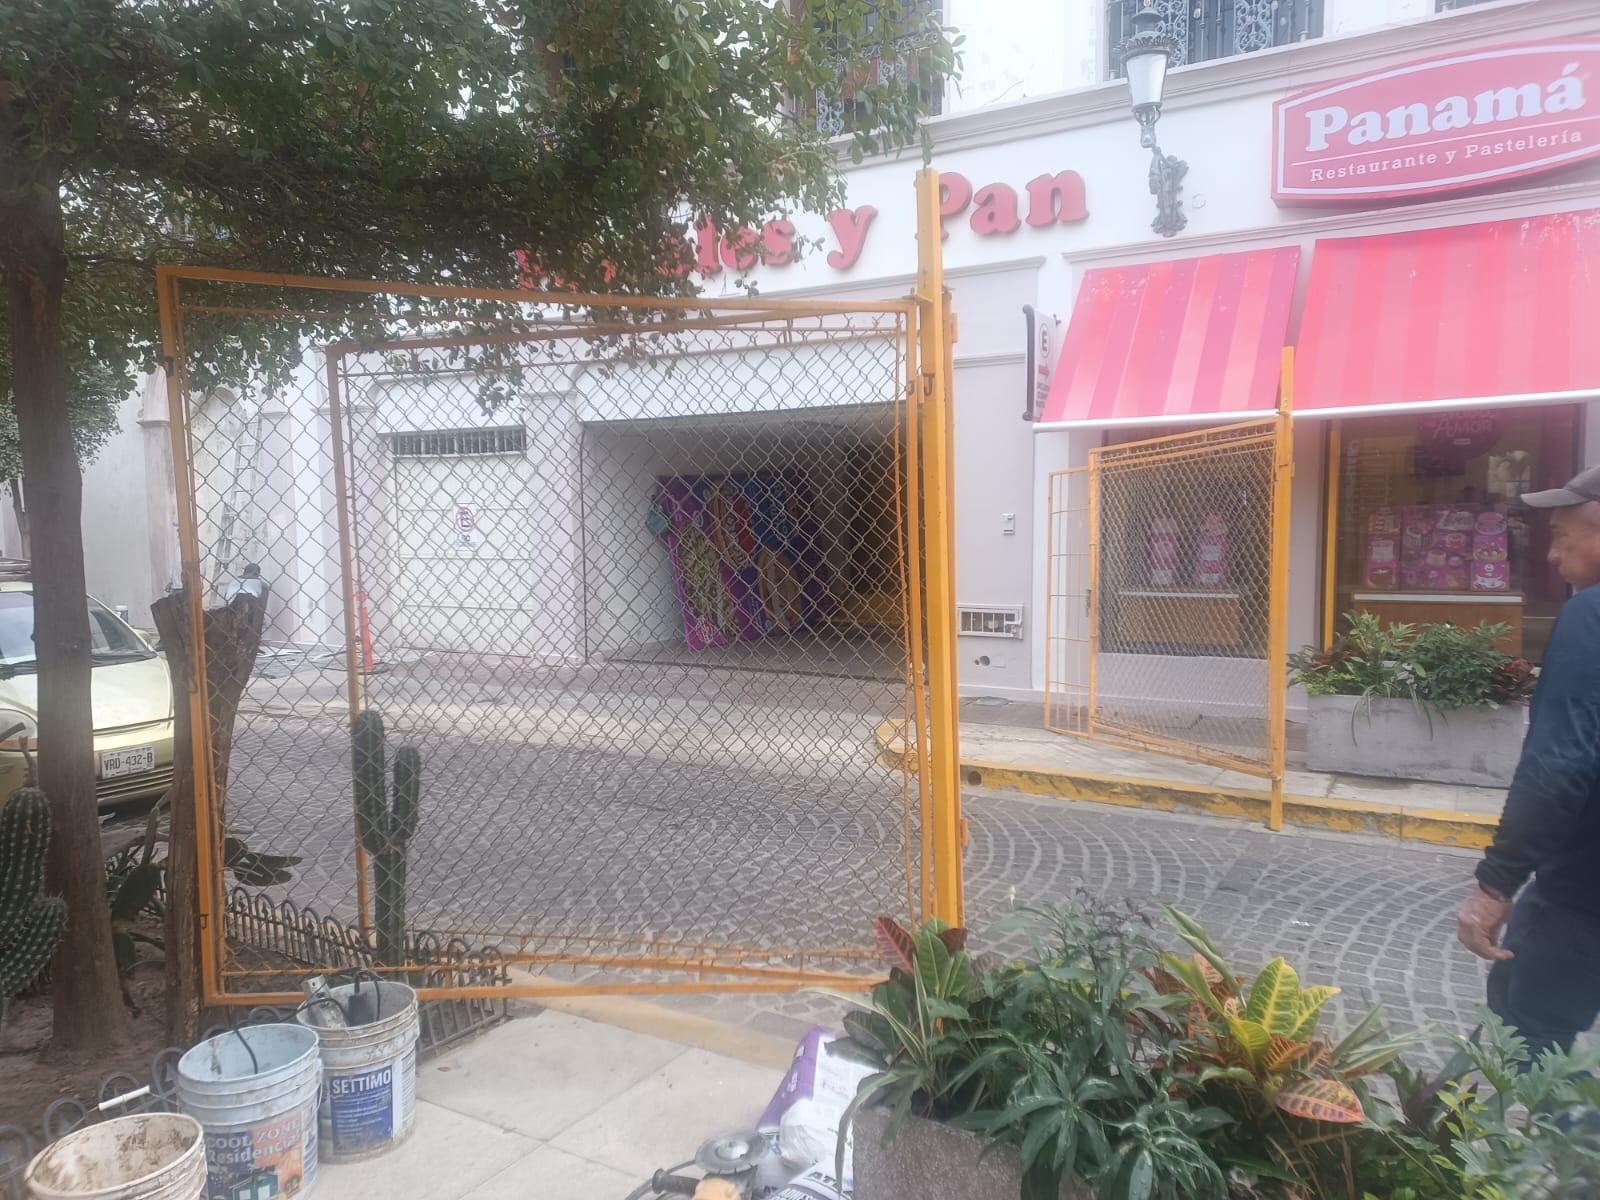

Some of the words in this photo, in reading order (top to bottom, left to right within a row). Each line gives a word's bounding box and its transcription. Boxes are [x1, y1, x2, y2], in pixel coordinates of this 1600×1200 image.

[1305, 62, 1586, 152] Panamá
[1310, 152, 1437, 182] Restaurante
[1445, 149, 1457, 164] y
[1465, 130, 1582, 158] Pastelería
[826, 205, 877, 270] y
[914, 169, 1090, 240] Pan
[103, 752, 153, 771] VRD-432-B
[332, 1069, 391, 1094] SETTIMO
[206, 1135, 252, 1149] COOL
